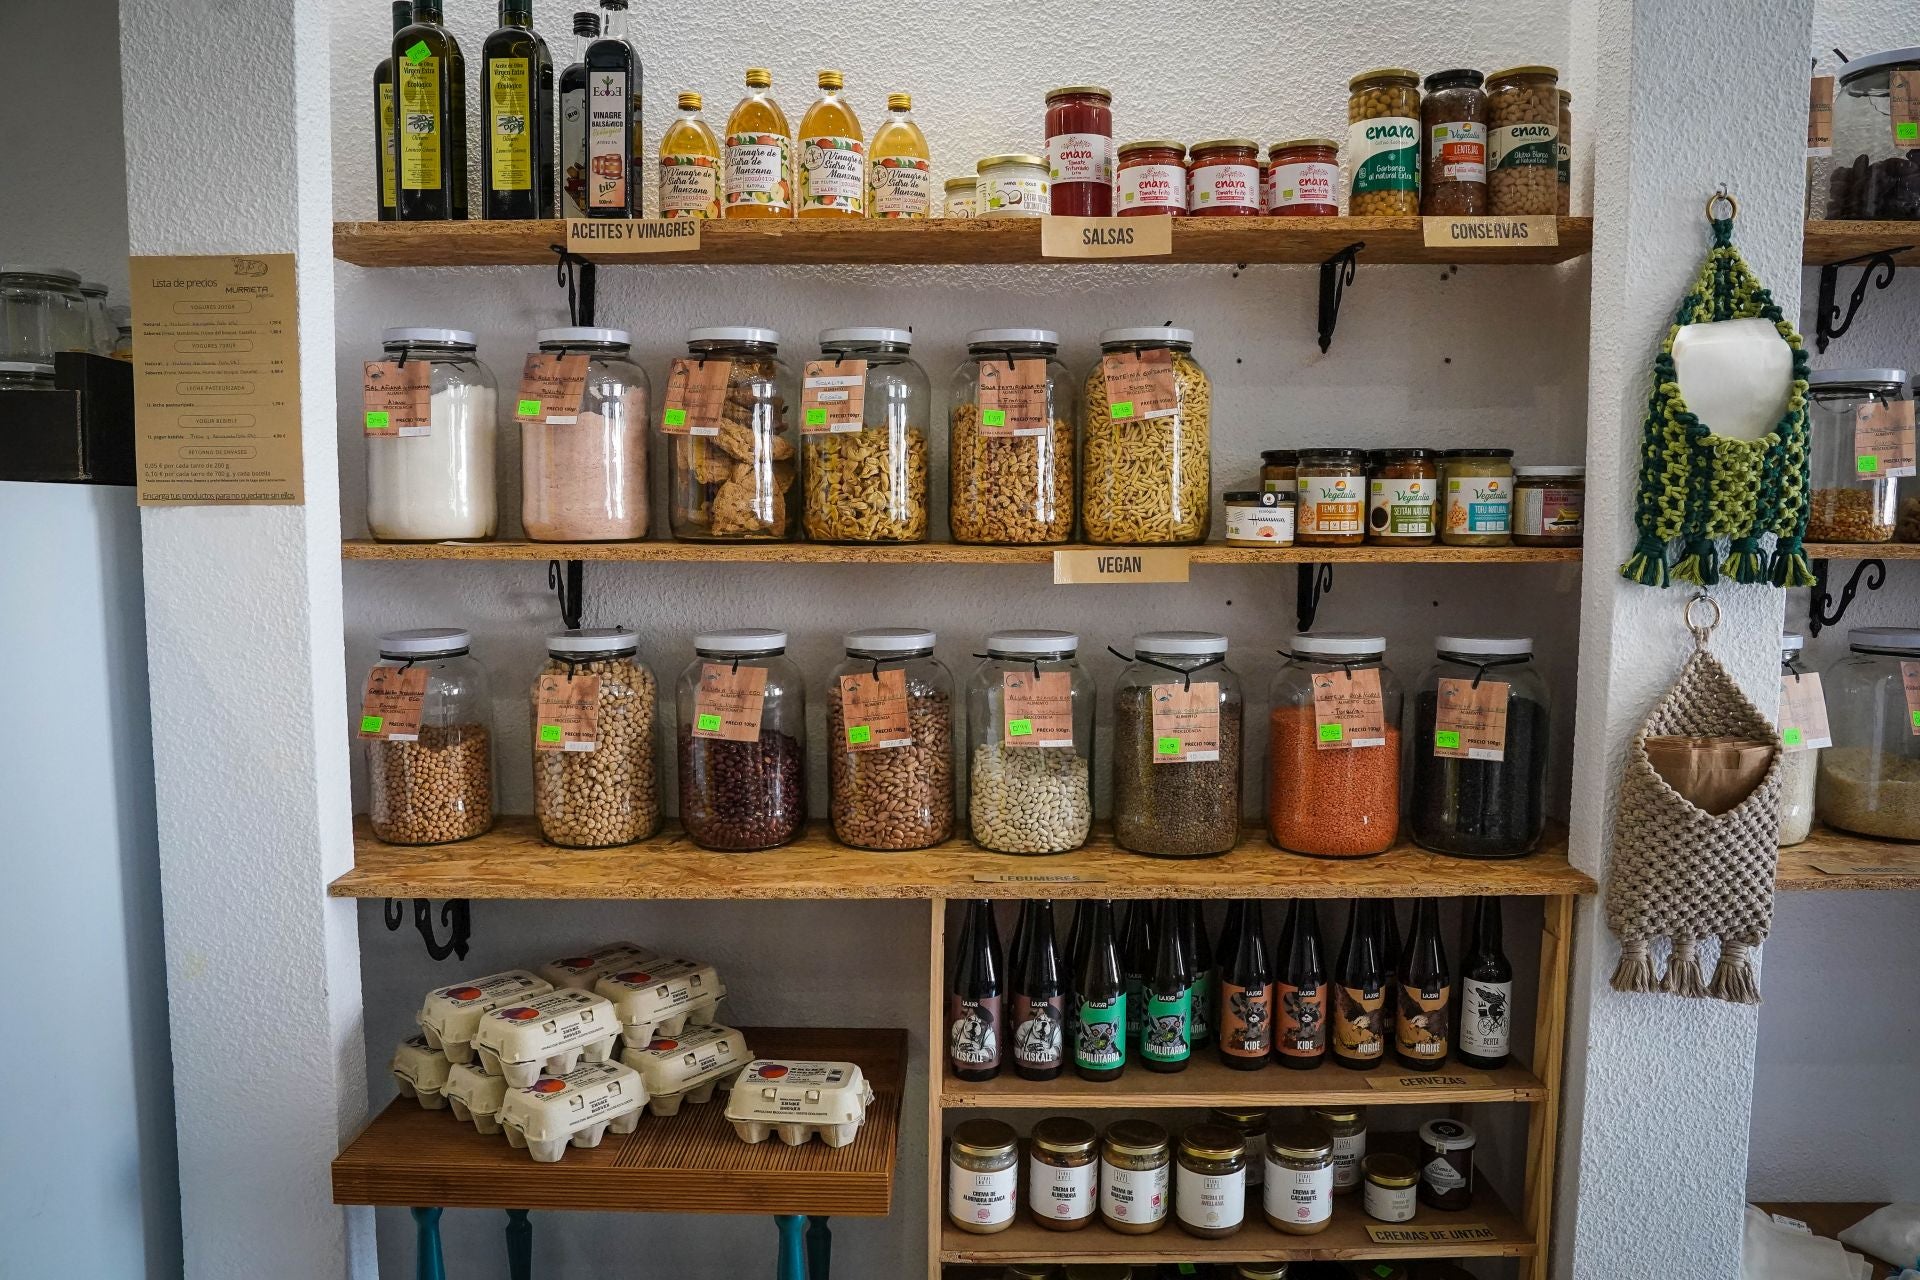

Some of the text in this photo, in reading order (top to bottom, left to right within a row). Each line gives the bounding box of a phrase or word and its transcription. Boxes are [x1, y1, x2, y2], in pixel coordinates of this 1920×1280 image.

[1366, 125, 1415, 140] enara
[1511, 126, 1551, 137] enara
[728, 147, 777, 158] Vinagre de
[1060, 150, 1092, 160] enara
[1454, 144, 1479, 155] LENTEJAS
[731, 158, 749, 166] Sidra
[824, 151, 857, 165] Vinagre
[733, 166, 772, 175] Manzana
[824, 160, 856, 172] Sidra de
[667, 168, 702, 179] Vinagre
[826, 169, 861, 182] Manzana
[889, 170, 921, 181] Vinagre
[668, 177, 688, 185] Sidra
[1138, 180, 1170, 189] enara
[1215, 180, 1245, 189] enara
[1299, 178, 1329, 187] enara
[670, 186, 708, 195] Manzana
[890, 188, 926, 198] Manzana
[571, 220, 695, 239] ACEITES Y VINAGRES
[1451, 222, 1529, 239] CONSERVAS
[1082, 227, 1134, 245] SALSAS
[152, 279, 218, 290] Lista de precios
[225, 286, 268, 294] MURRIETA
[1320, 488, 1356, 501] Vegetalia
[1394, 490, 1430, 504] Vegetalia
[1473, 488, 1507, 502] Vegetalia
[1475, 505, 1487, 513] TOFU
[1097, 556, 1142, 573] VEGAN
[1244, 1040, 1261, 1051] KIDE
[1297, 1040, 1314, 1050] KIDE
[1415, 1042, 1440, 1053] HORIXE
[956, 1051, 983, 1063] KISKALE
[1023, 1051, 1052, 1062] KISKALE
[1399, 1076, 1467, 1087] CERVEZAS
[1111, 1185, 1127, 1194] CREMA
[988, 1194, 1005, 1202] BLANCA
[1375, 1228, 1494, 1241] CREMAS DE UNTAR
